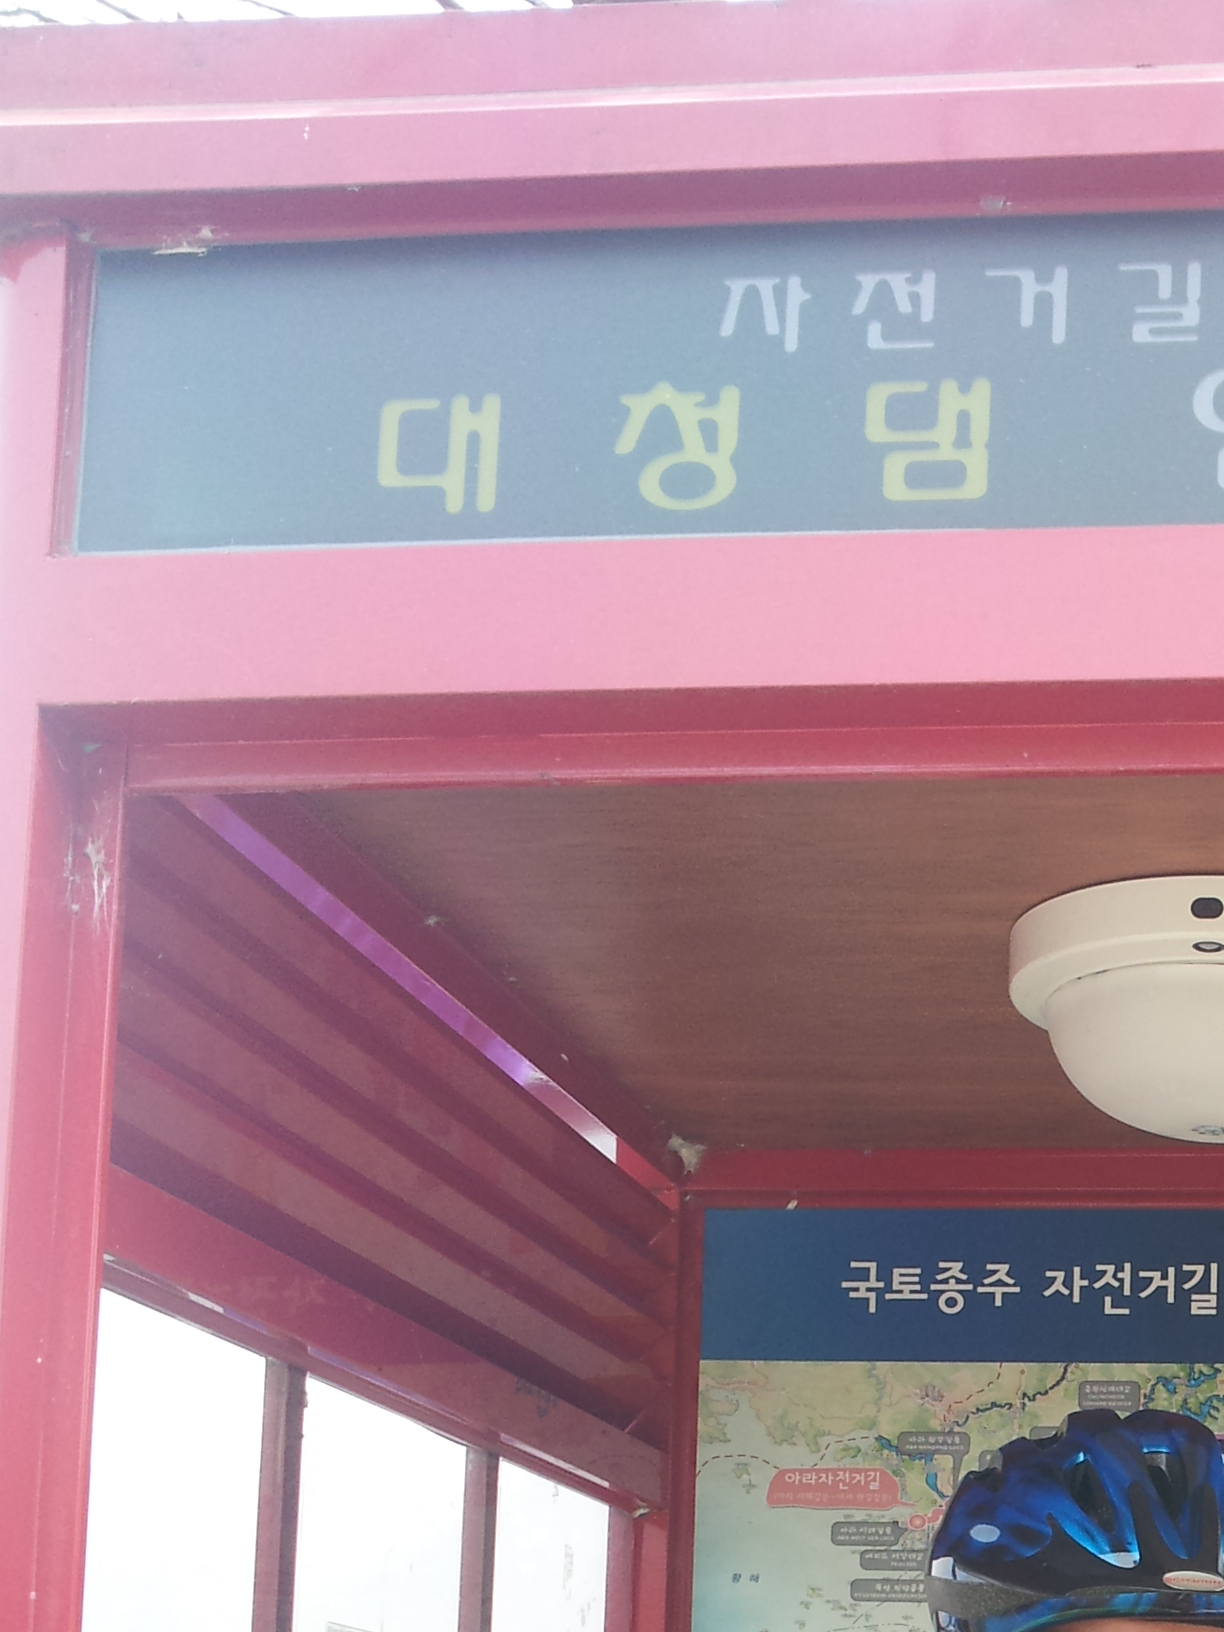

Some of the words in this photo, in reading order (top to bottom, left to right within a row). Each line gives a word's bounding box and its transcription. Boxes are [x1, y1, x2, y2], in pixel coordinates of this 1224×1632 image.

[718, 260, 1202, 353] 자전거길
[376, 376, 991, 515] 대청댐
[840, 1260, 1022, 1315] 국토종주
[1042, 1261, 1219, 1316] 자전거길
[785, 1470, 881, 1490] 아라자전거길
